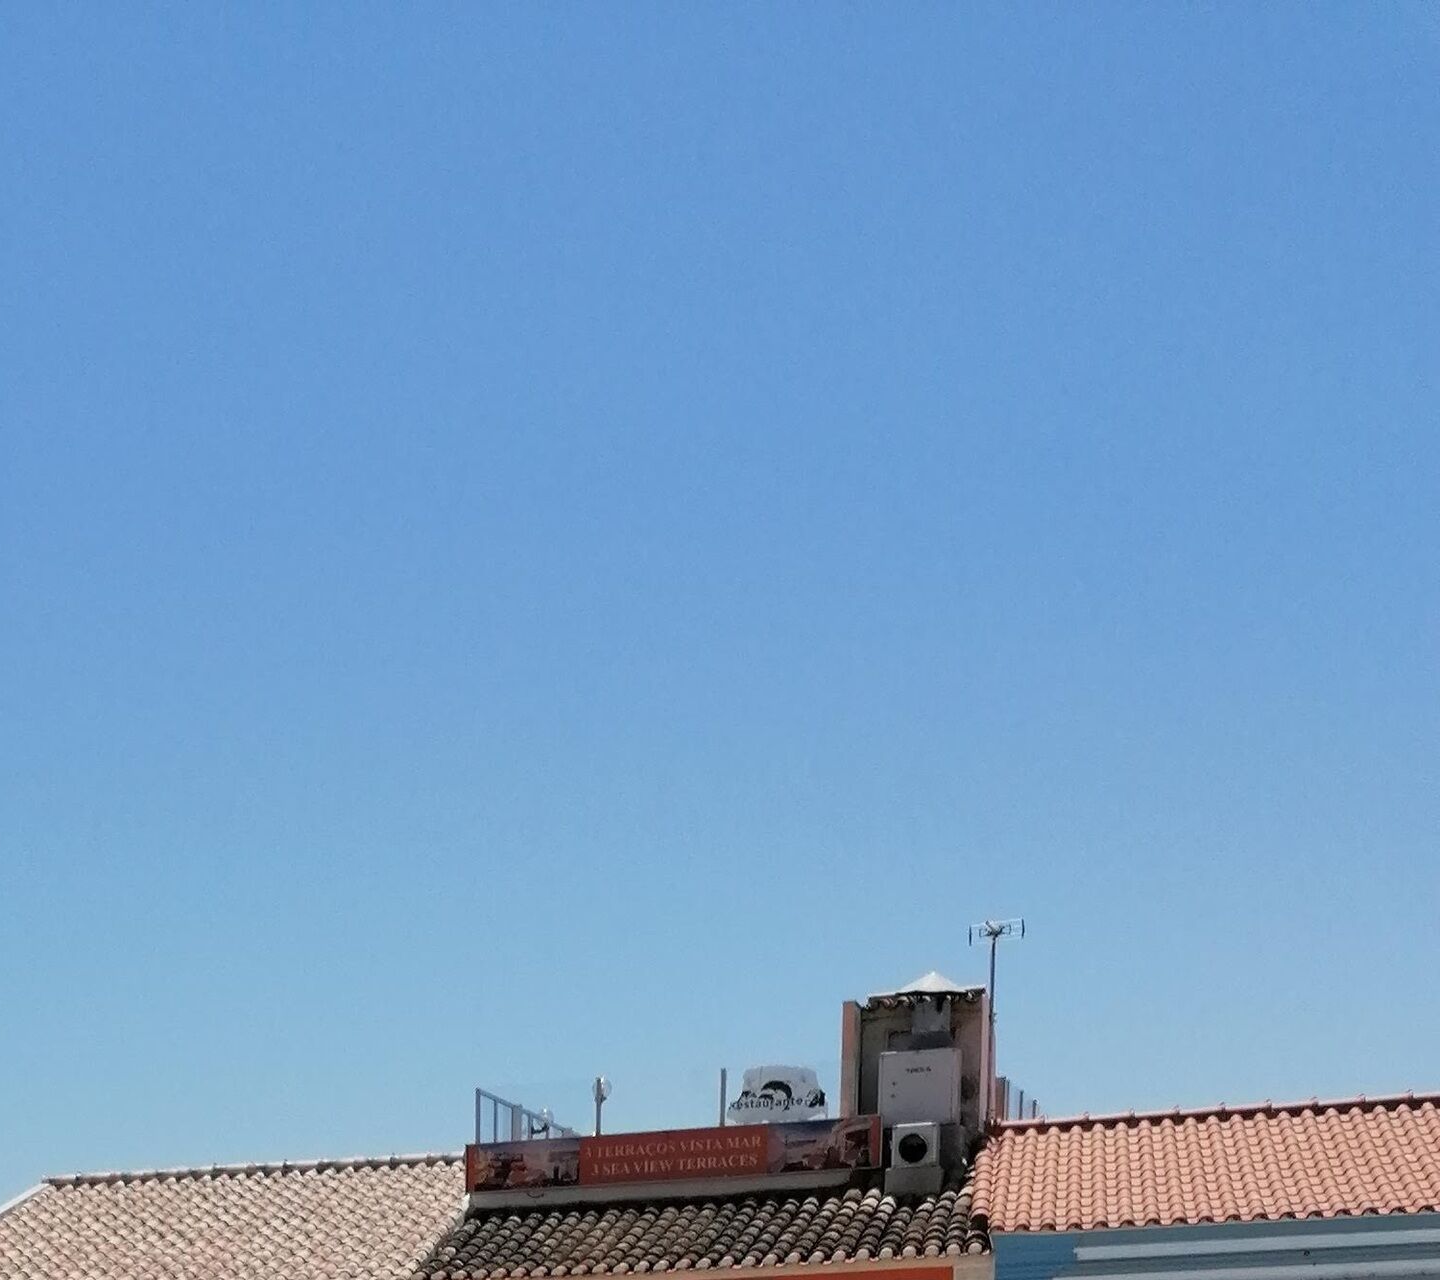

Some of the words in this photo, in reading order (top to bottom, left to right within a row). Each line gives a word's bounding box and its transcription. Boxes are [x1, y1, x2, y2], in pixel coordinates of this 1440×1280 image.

[597, 1141, 676, 1158] TERRAÇOS
[680, 1138, 723, 1153] VISTA
[726, 1135, 761, 1149] MAR
[602, 1162, 630, 1176] SEA
[633, 1158, 674, 1173] VIEW
[678, 1153, 758, 1170] TERRACES
